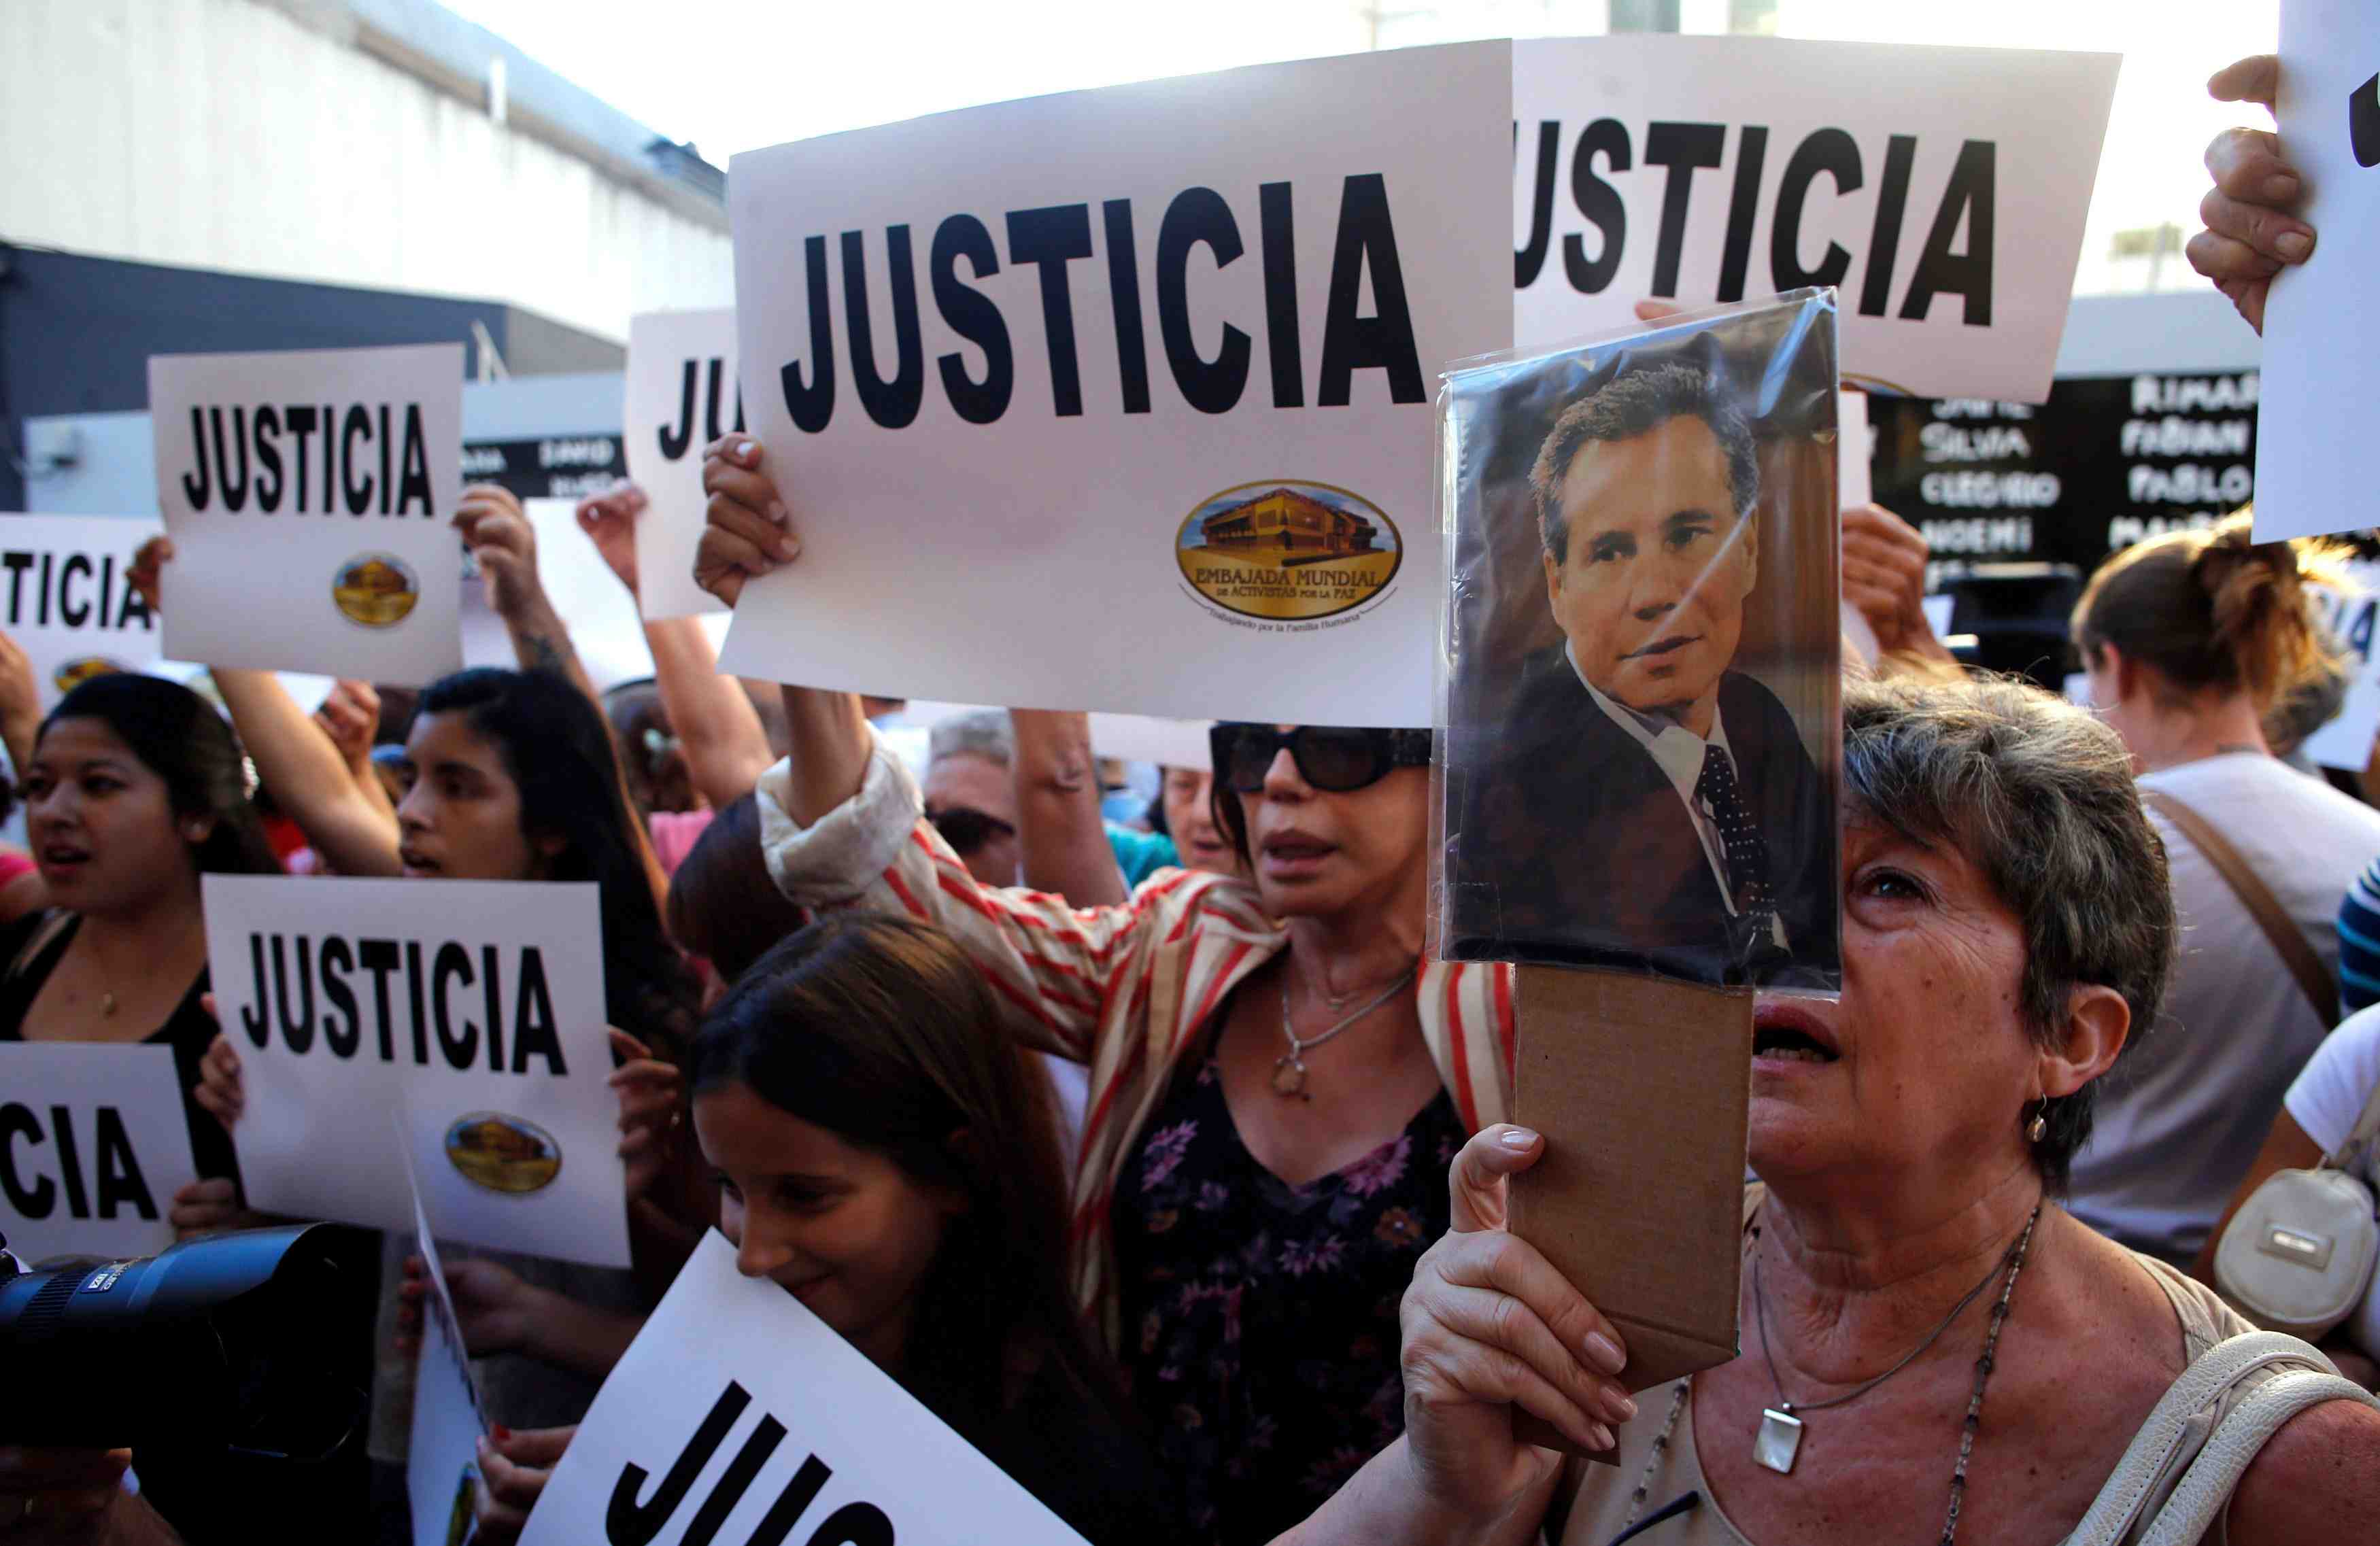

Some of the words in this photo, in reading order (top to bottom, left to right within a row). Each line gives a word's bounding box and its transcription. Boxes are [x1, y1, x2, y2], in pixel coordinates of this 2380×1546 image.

[781, 173, 1427, 434] JUSTICIA
[181, 402, 435, 518] JUSTICIA
[2128, 463, 2254, 503] PABLO
[1195, 568, 1290, 585] EMBAJADA
[1296, 570, 1381, 587] MUNDIAL
[1231, 587, 1297, 598] ACTIVISTAS
[1333, 588, 1357, 599] PAZ
[1209, 607, 1257, 630] Trabajando
[1258, 622, 1274, 633] por
[1276, 622, 1285, 632] la
[1286, 621, 1319, 633] Familia
[1320, 613, 1361, 630] Humana
[240, 932, 570, 1076] JUSTICIA
[0, 1101, 159, 1220] CIA
